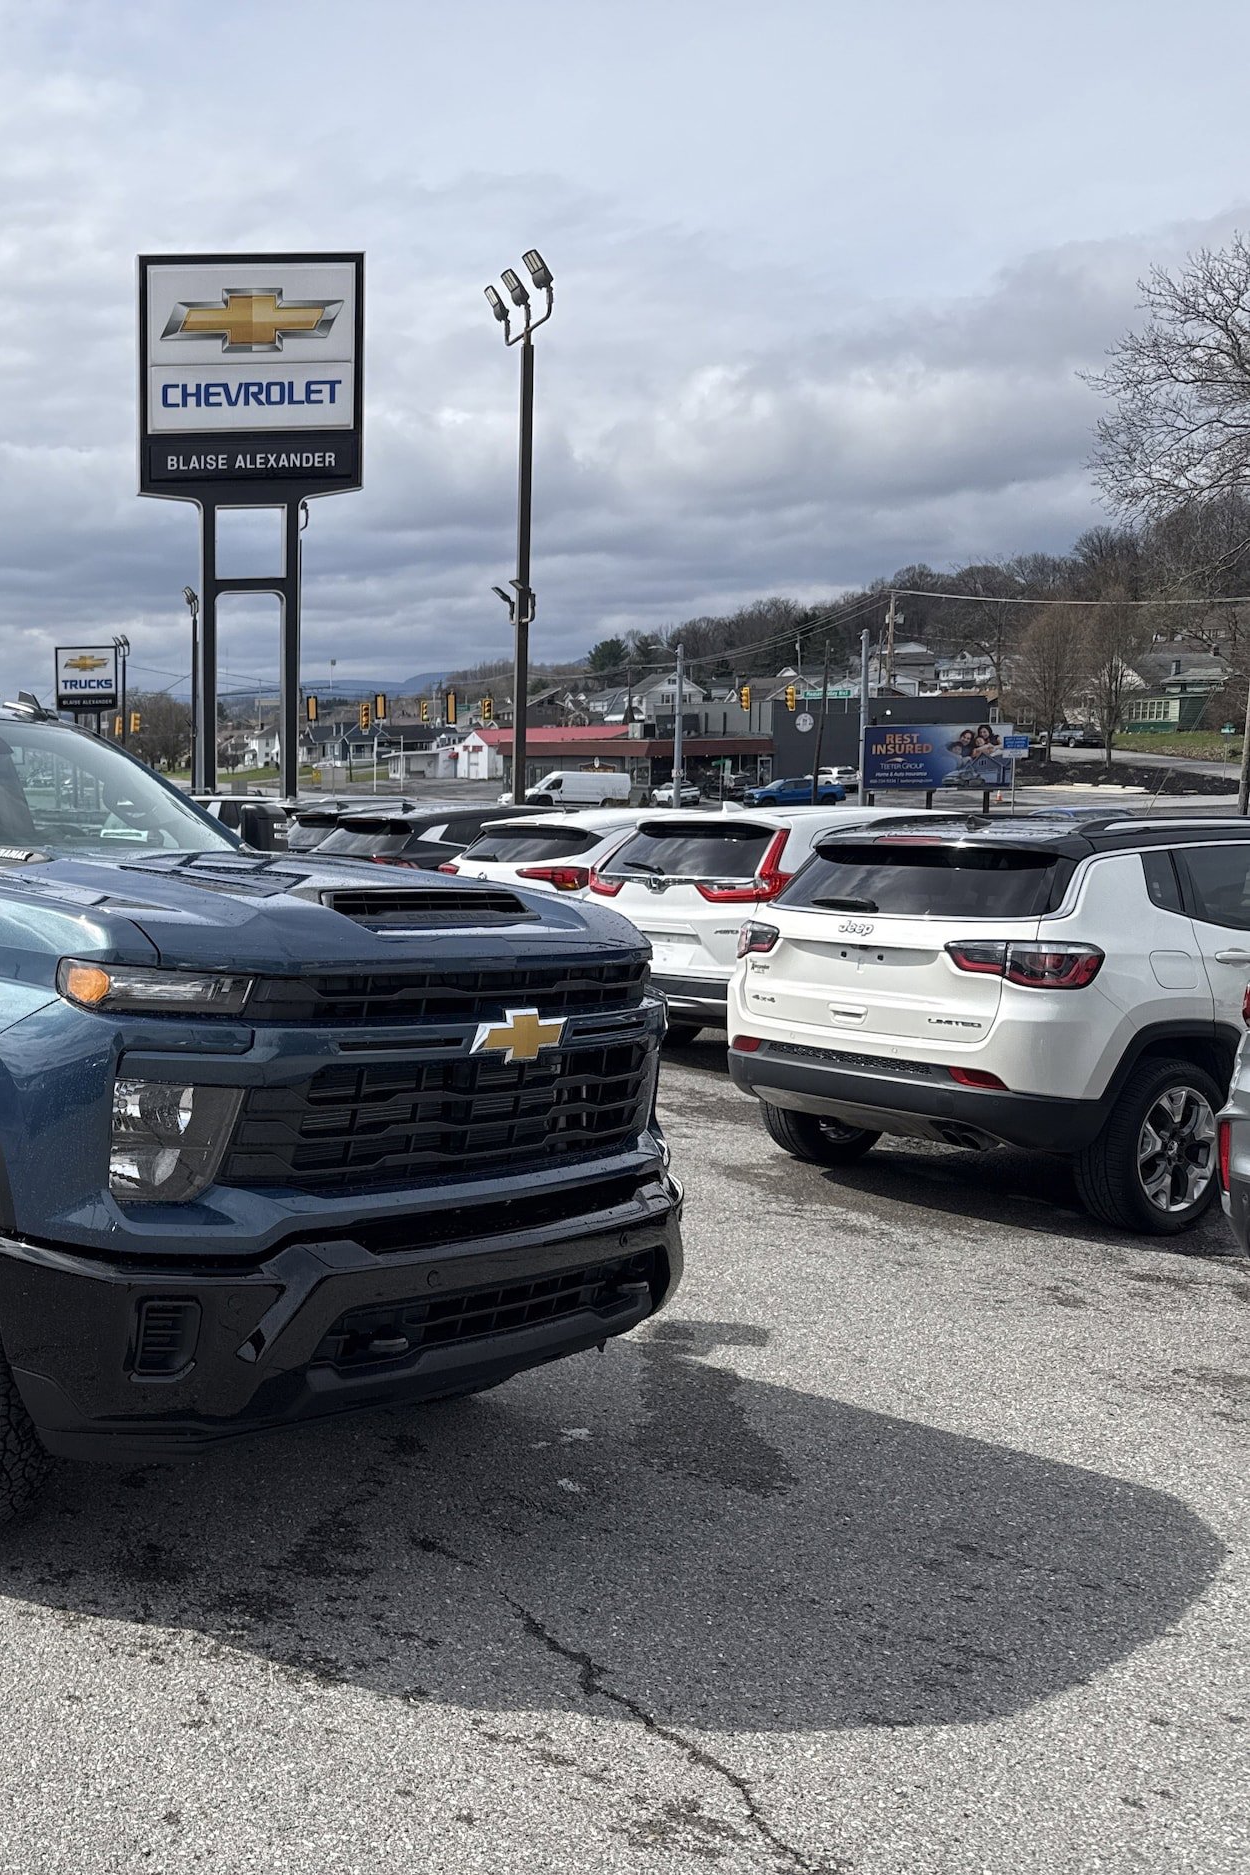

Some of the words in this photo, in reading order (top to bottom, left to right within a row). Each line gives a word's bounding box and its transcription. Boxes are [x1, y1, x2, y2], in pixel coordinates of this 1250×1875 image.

[161, 379, 342, 408] CHEVROLET
[166, 455, 228, 470] BLAISE
[234, 452, 336, 469] ALEXANDER
[61, 679, 113, 690] TRUCKS
[885, 733, 920, 744] REST
[871, 743, 933, 755] INSURED
[838, 919, 875, 937] Jeep
[928, 1018, 982, 1028] LIMITED
